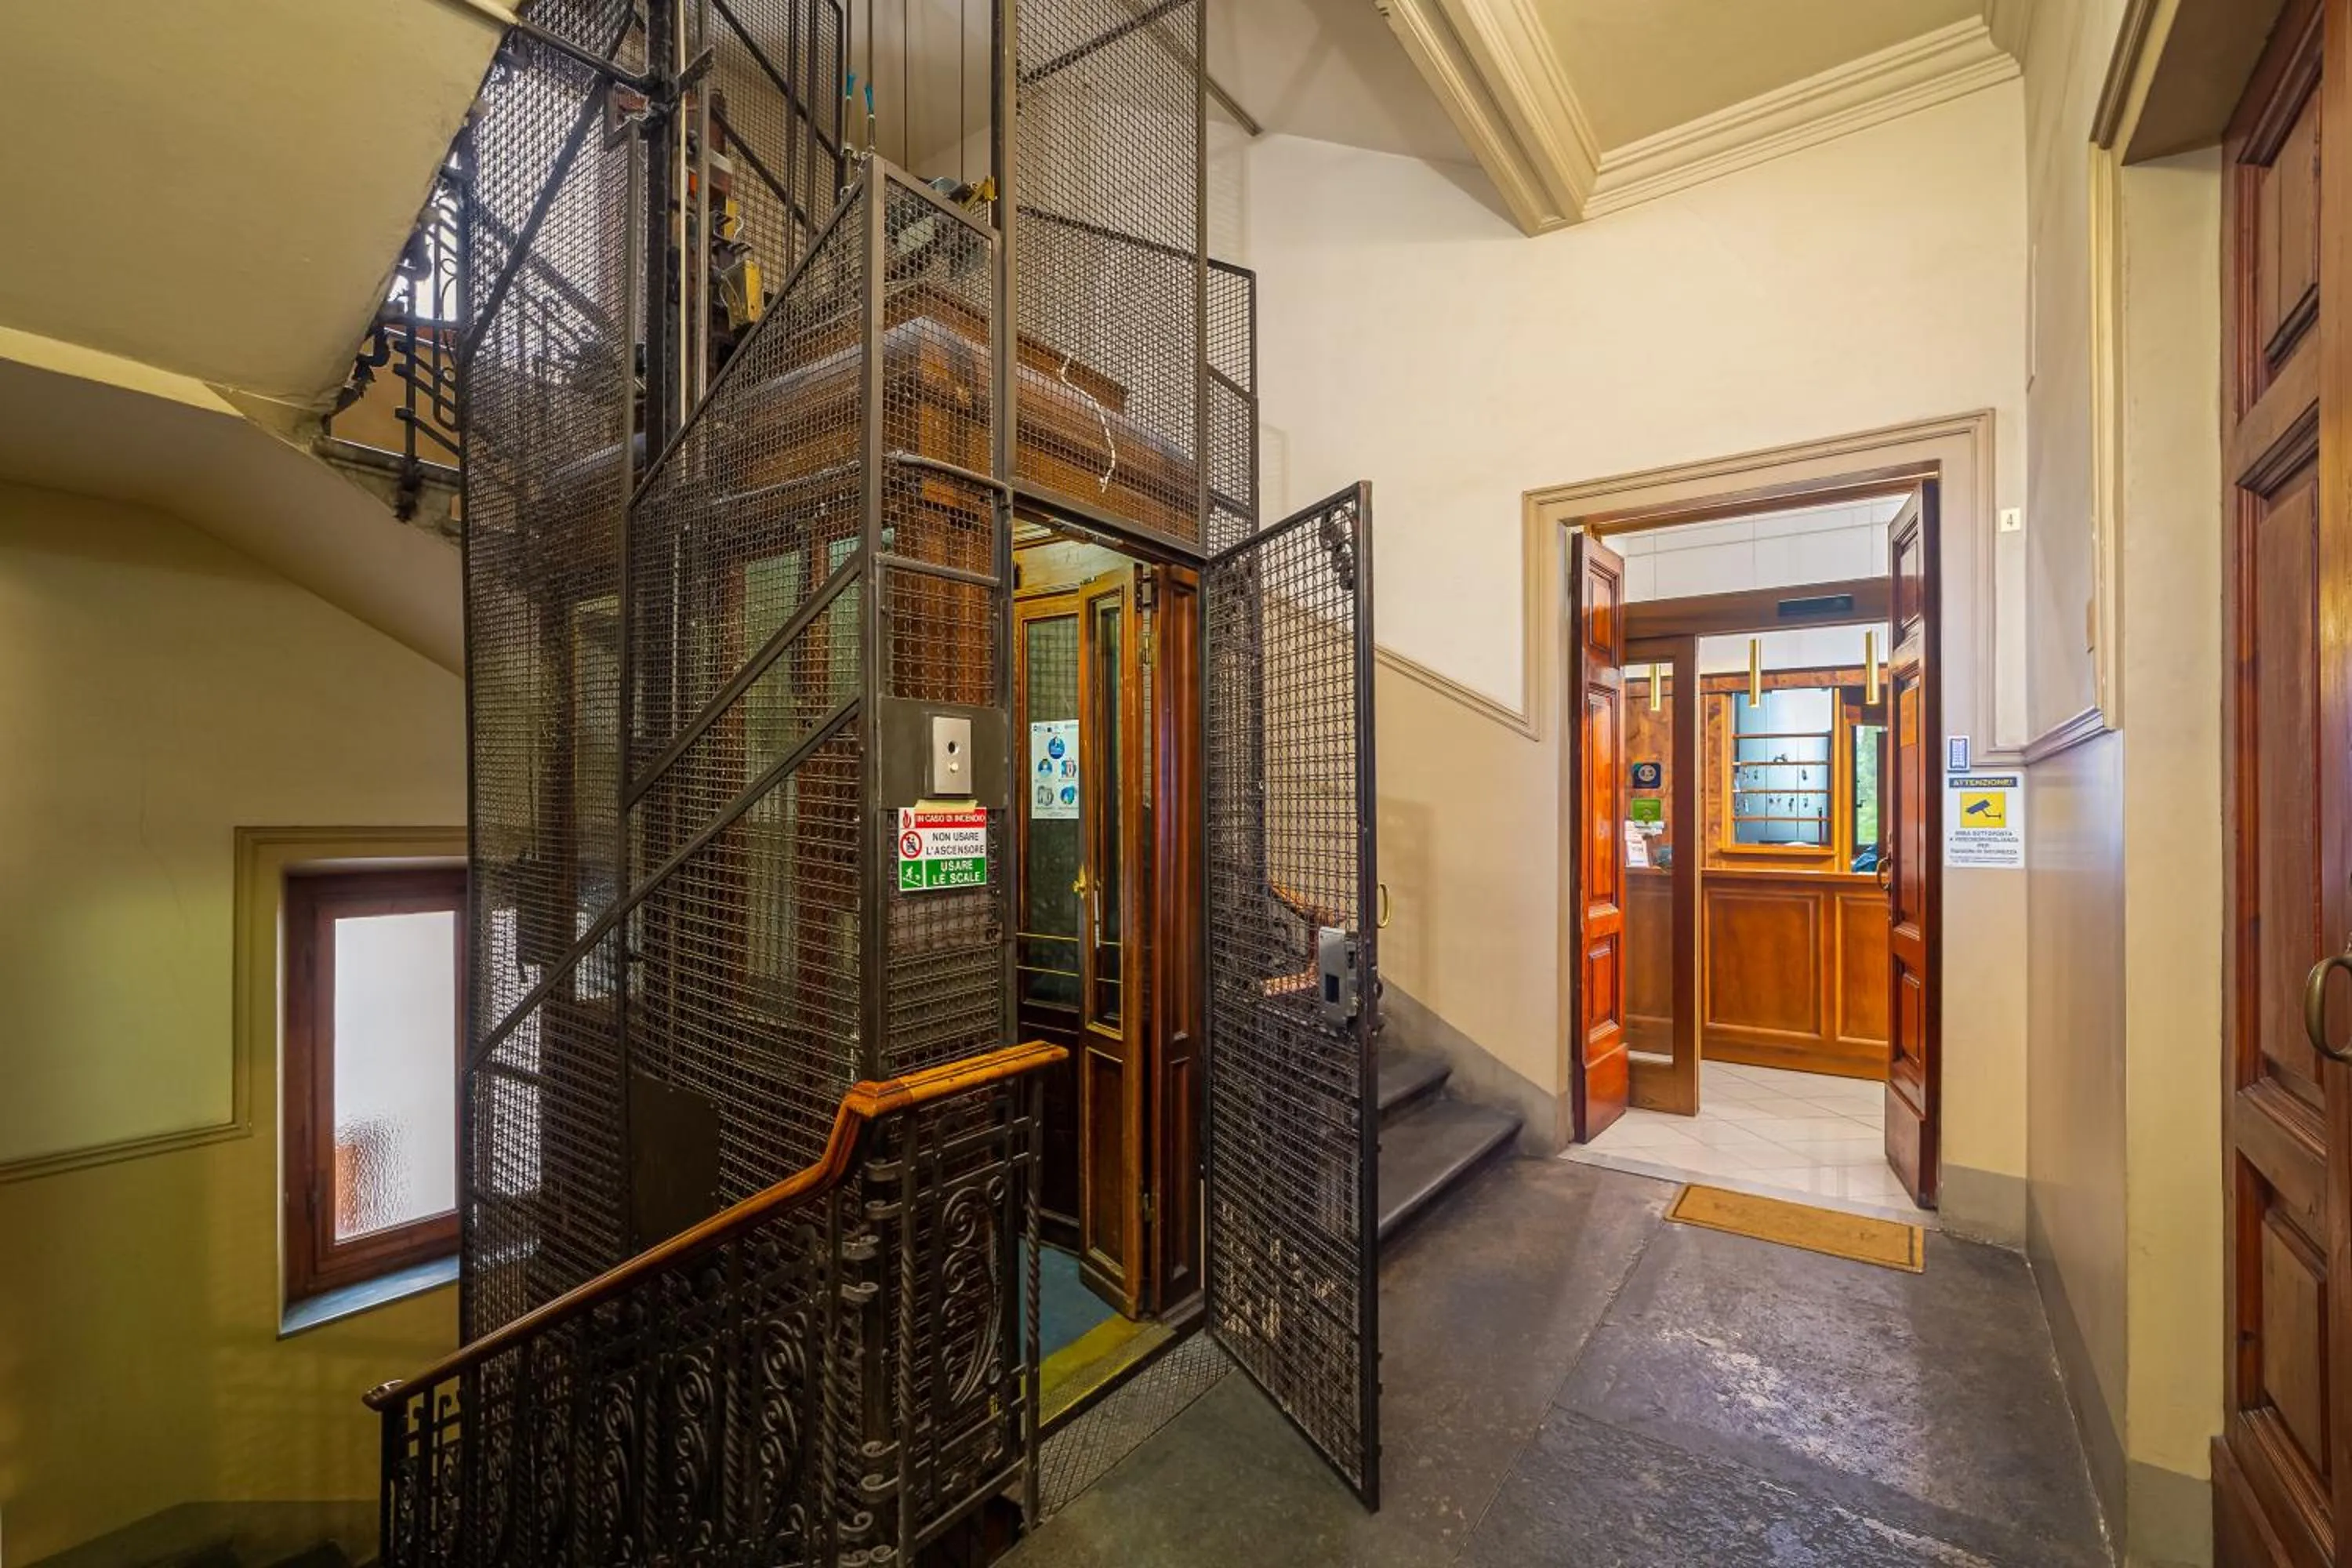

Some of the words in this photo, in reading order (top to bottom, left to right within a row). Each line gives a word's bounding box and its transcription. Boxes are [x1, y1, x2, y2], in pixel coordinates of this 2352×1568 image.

[2006, 514, 2013, 527] 4
[916, 814, 924, 822] IN
[925, 814, 944, 822] CASO
[946, 814, 953, 822] DI
[956, 813, 985, 822] INCENDIO
[932, 832, 951, 841] NON
[953, 832, 979, 841] USARE
[926, 845, 985, 855] L'ASCENSORE
[941, 860, 974, 872] USARE
[932, 874, 946, 885] LE
[949, 872, 981, 884] SCALE
